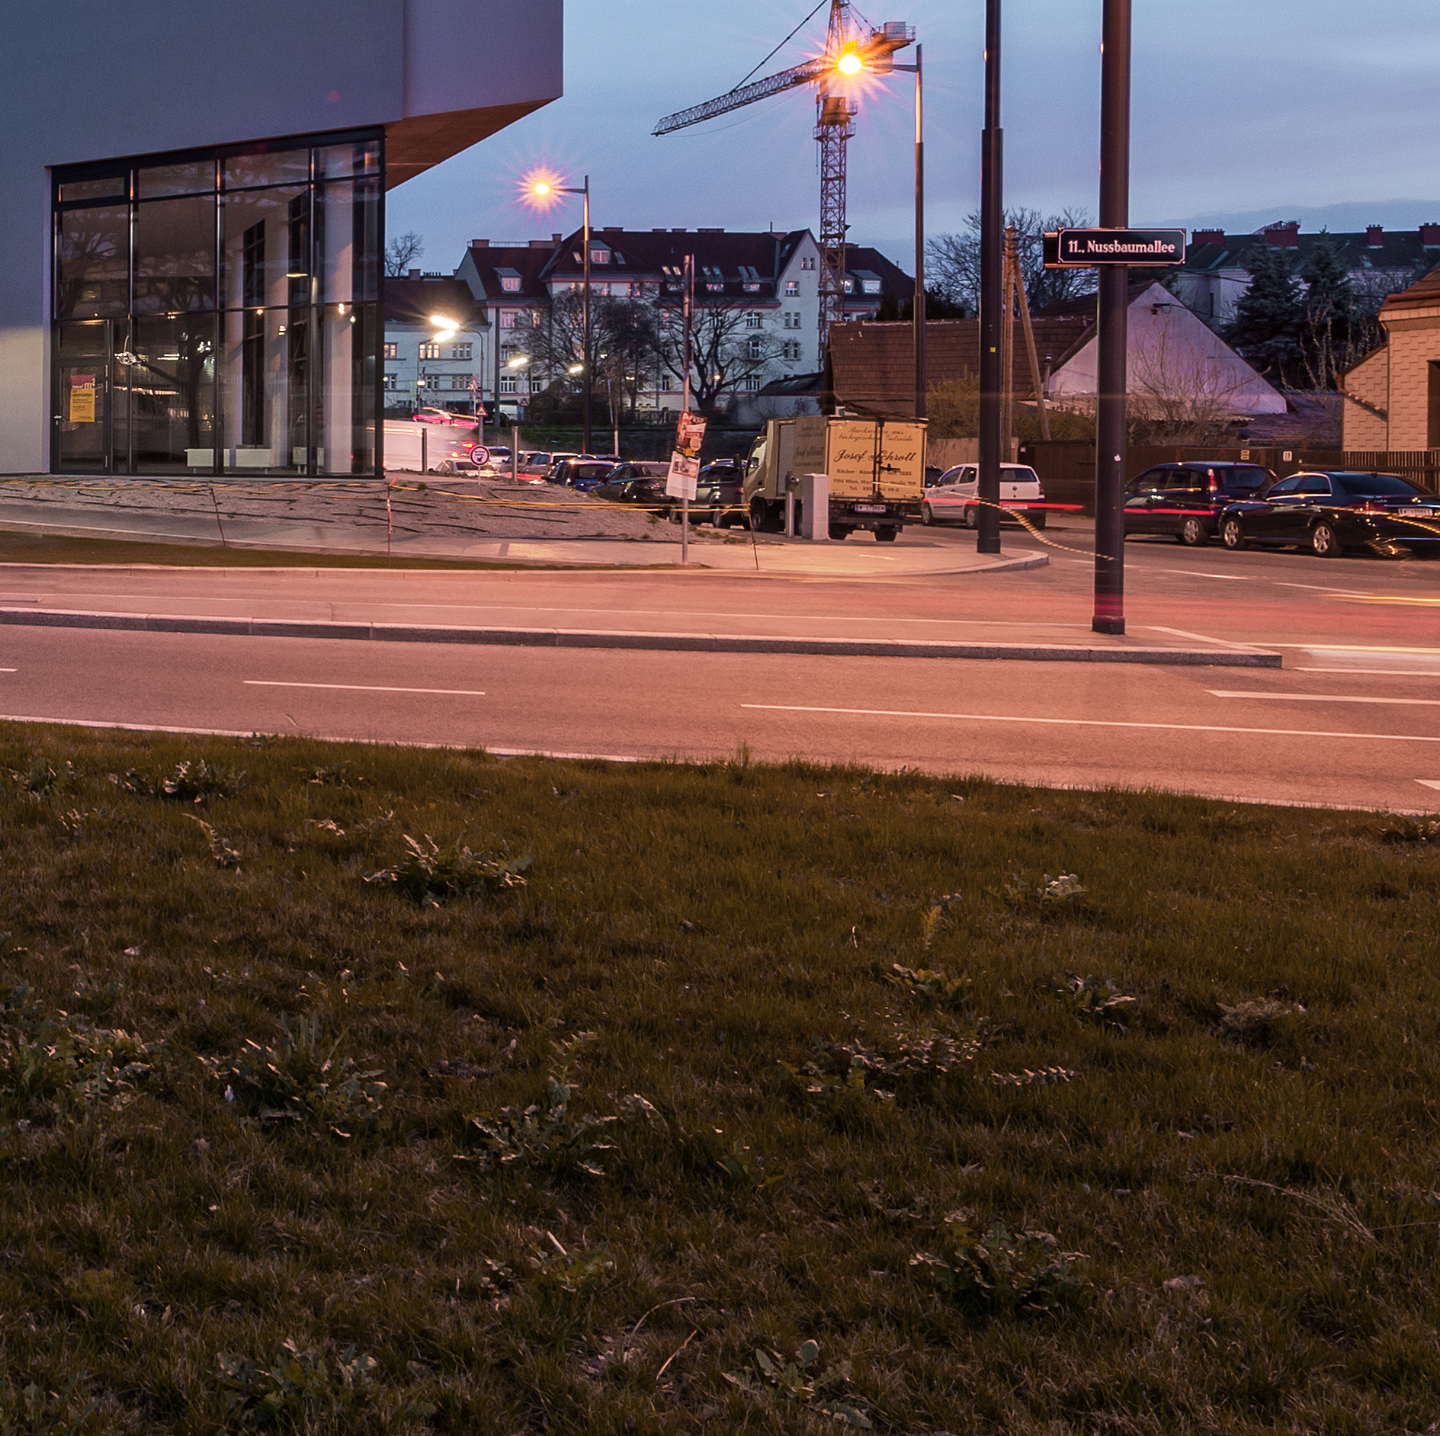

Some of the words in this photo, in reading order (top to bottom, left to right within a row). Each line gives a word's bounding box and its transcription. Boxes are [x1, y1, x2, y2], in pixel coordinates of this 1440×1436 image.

[1068, 240, 1085, 253] 11.,
[1087, 240, 1175, 253] Nussbaumallee
[833, 450, 868, 462] Josef
